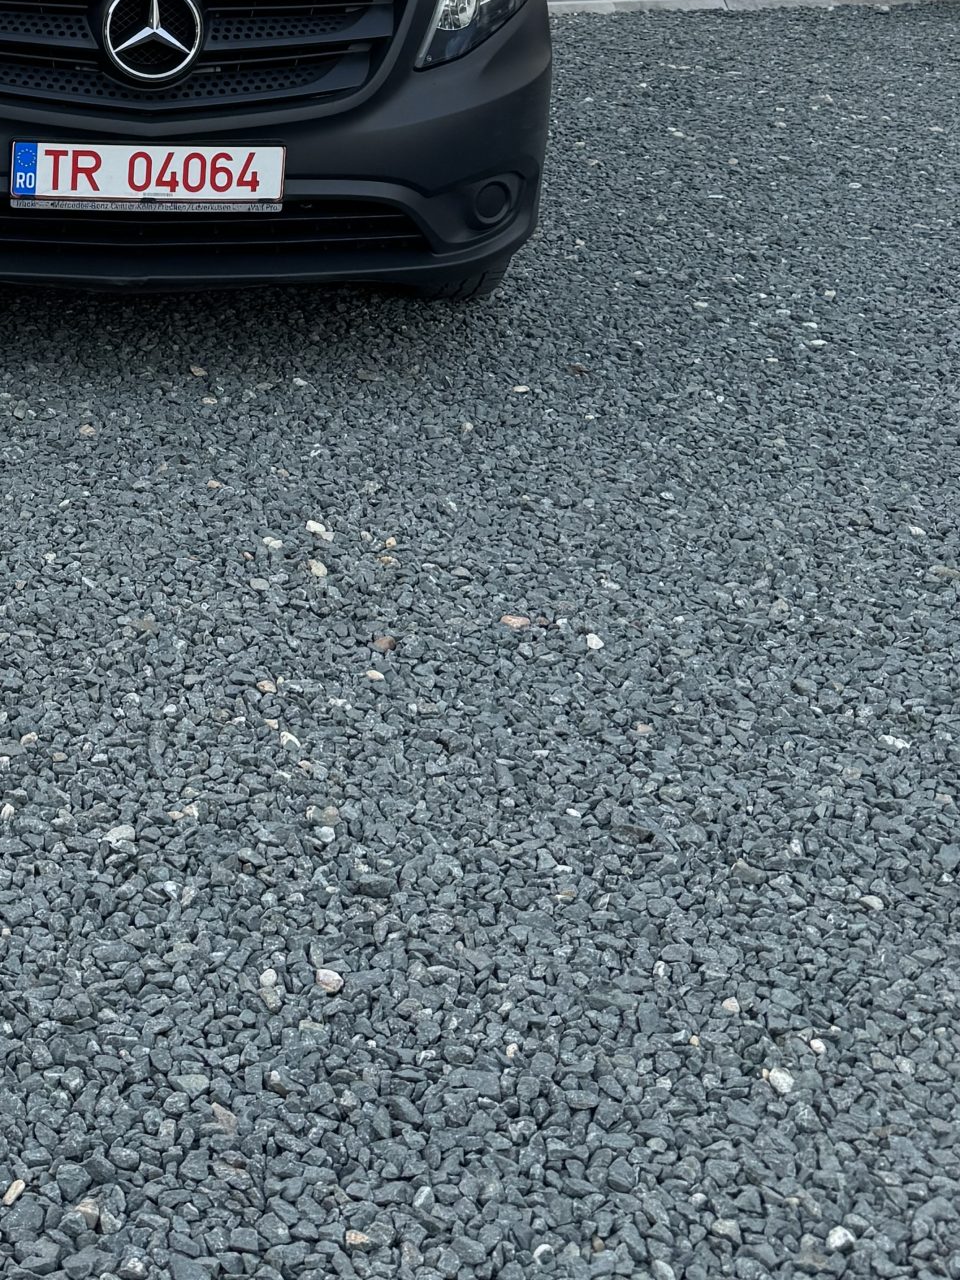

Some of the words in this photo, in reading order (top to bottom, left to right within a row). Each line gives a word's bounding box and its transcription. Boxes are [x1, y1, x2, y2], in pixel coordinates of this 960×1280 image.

[16, 172, 35, 189] RO
[45, 150, 102, 191] TR
[128, 151, 260, 193] 04064
